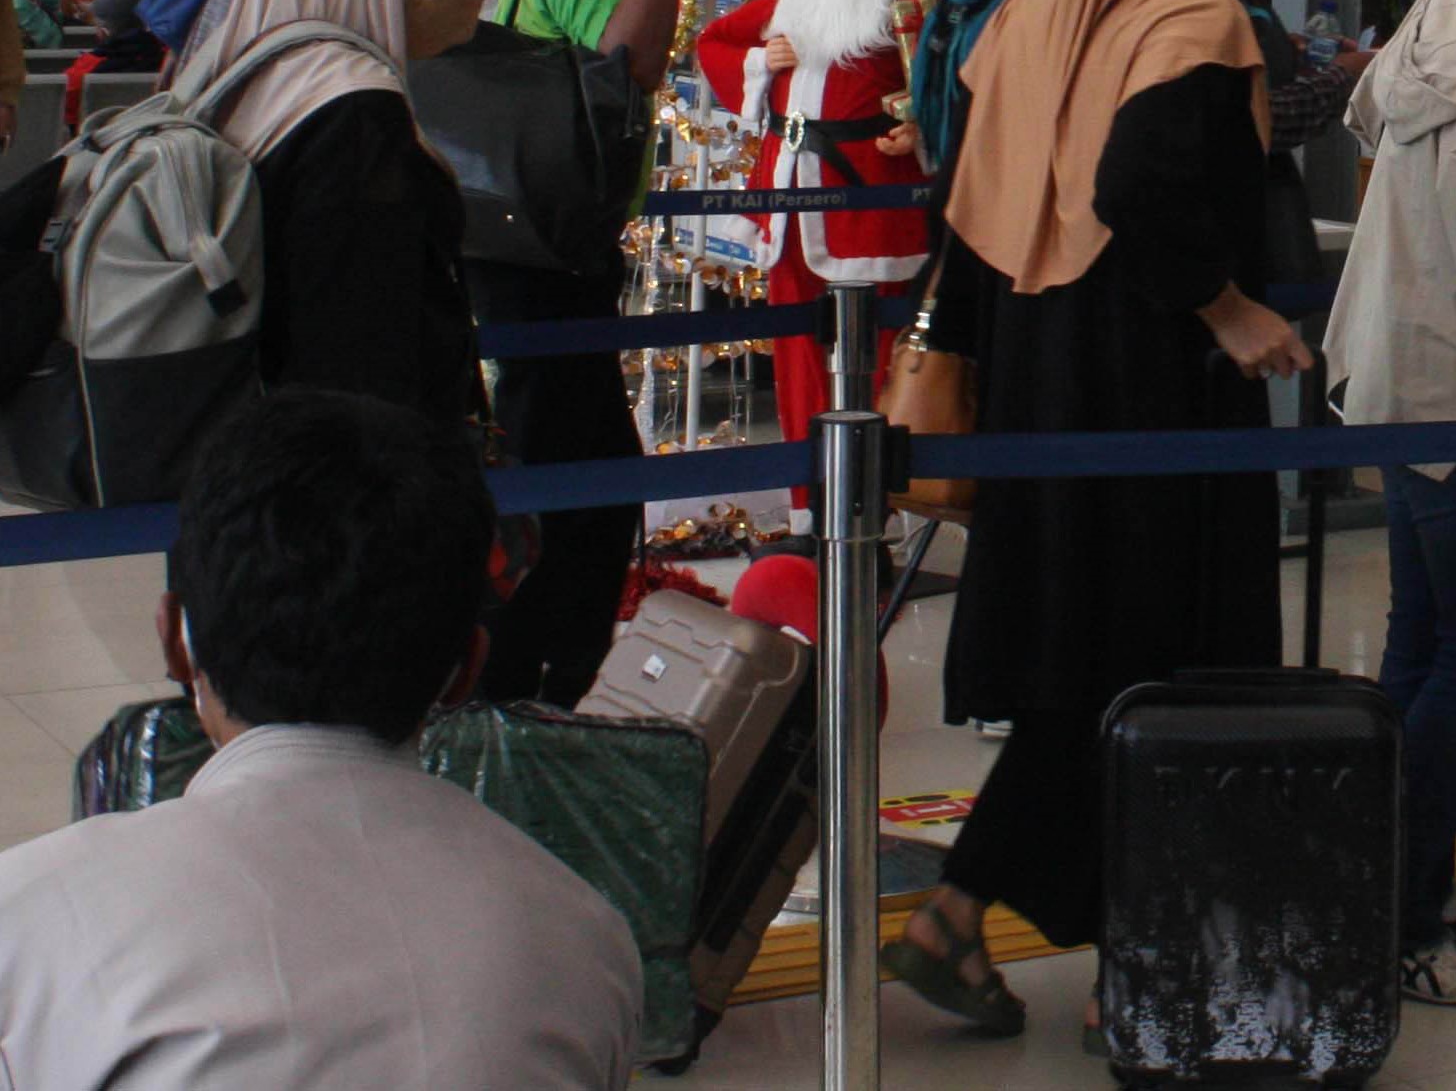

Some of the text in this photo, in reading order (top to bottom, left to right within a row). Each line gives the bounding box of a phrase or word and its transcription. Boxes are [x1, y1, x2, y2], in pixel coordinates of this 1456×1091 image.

[702, 191, 847, 210] PT KAI (Persero)
